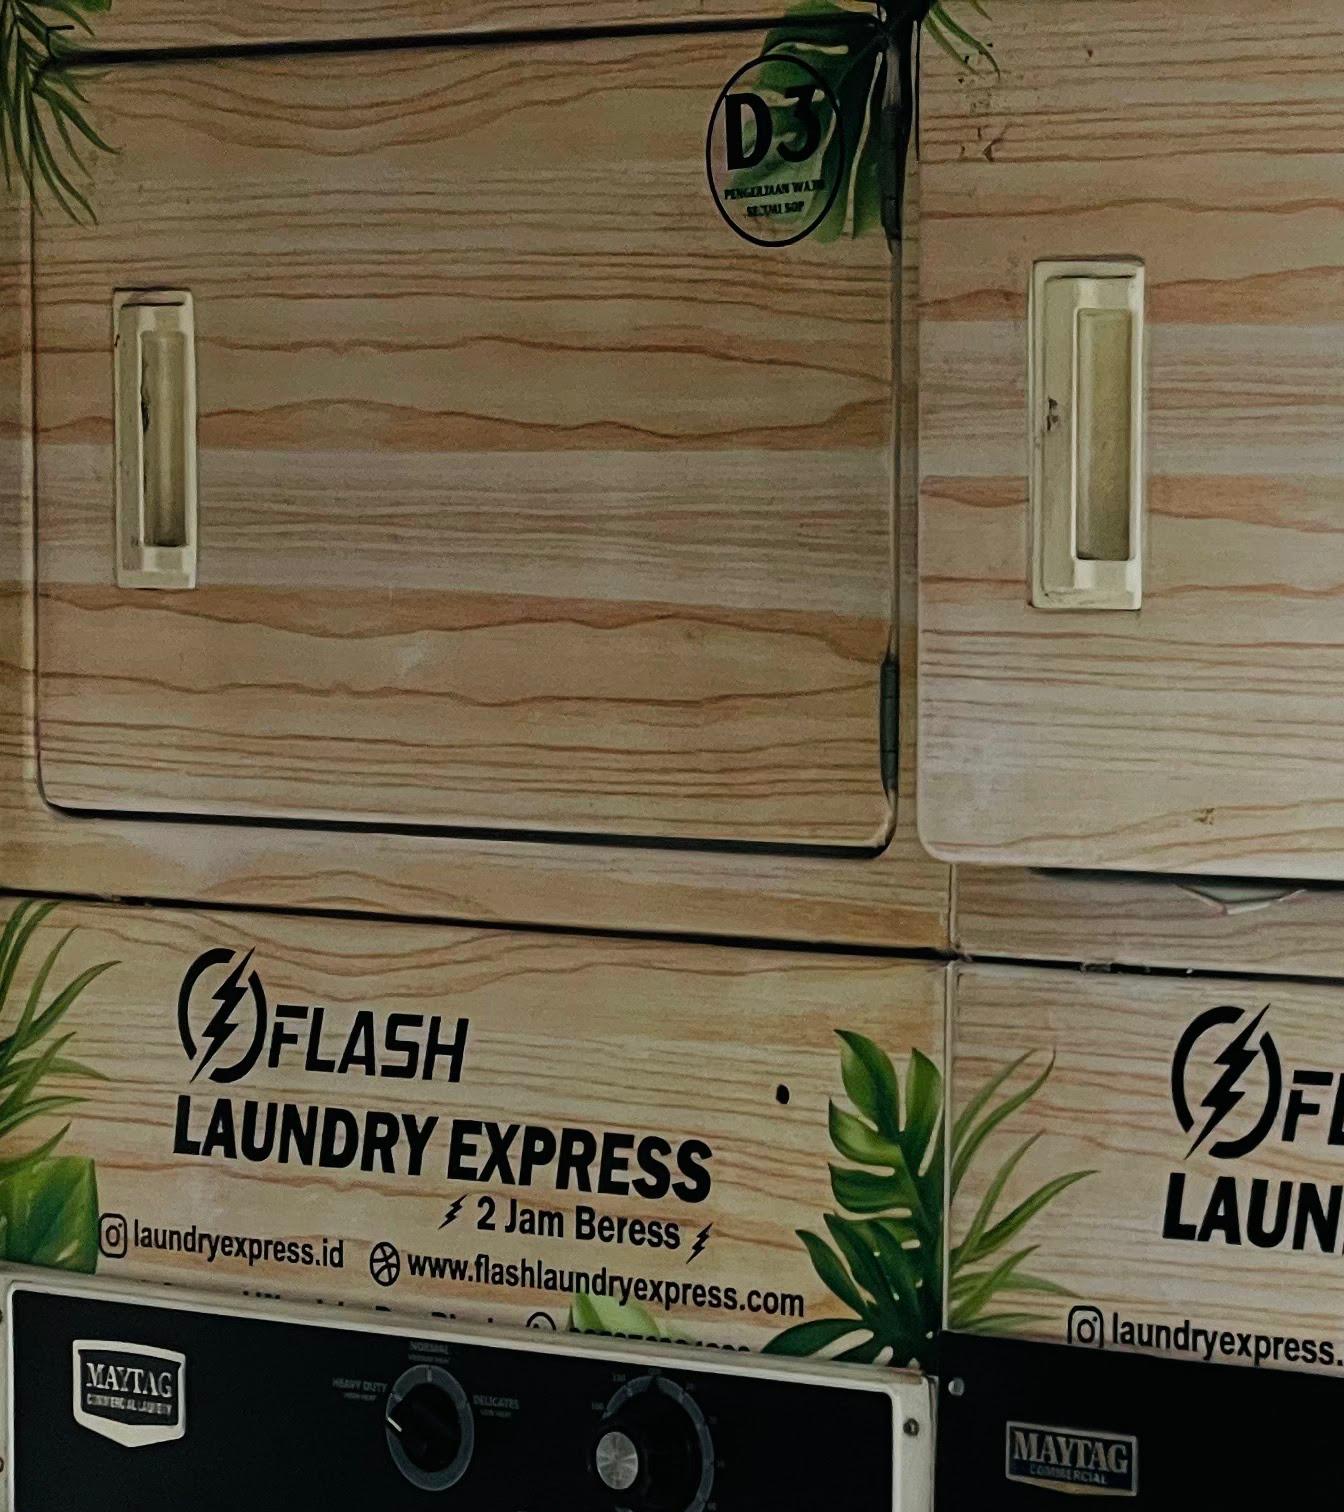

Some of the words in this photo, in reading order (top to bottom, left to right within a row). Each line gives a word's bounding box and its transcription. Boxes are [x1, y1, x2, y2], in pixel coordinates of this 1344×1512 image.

[724, 85, 823, 171] D3
[266, 1003, 470, 1083] FLASH
[172, 1095, 439, 1176] LAUNDRY
[447, 1119, 713, 1203] EXPRESS
[476, 1197, 497, 1231] 2
[504, 1198, 565, 1240] Jam
[575, 1204, 682, 1251] Beress
[133, 1219, 345, 1270] laundryexpress.id
[407, 1251, 806, 1318] www.flashlaundryexpress.com
[86, 1362, 173, 1398] MAYTAG
[1014, 1430, 1129, 1474] MAYTAG
